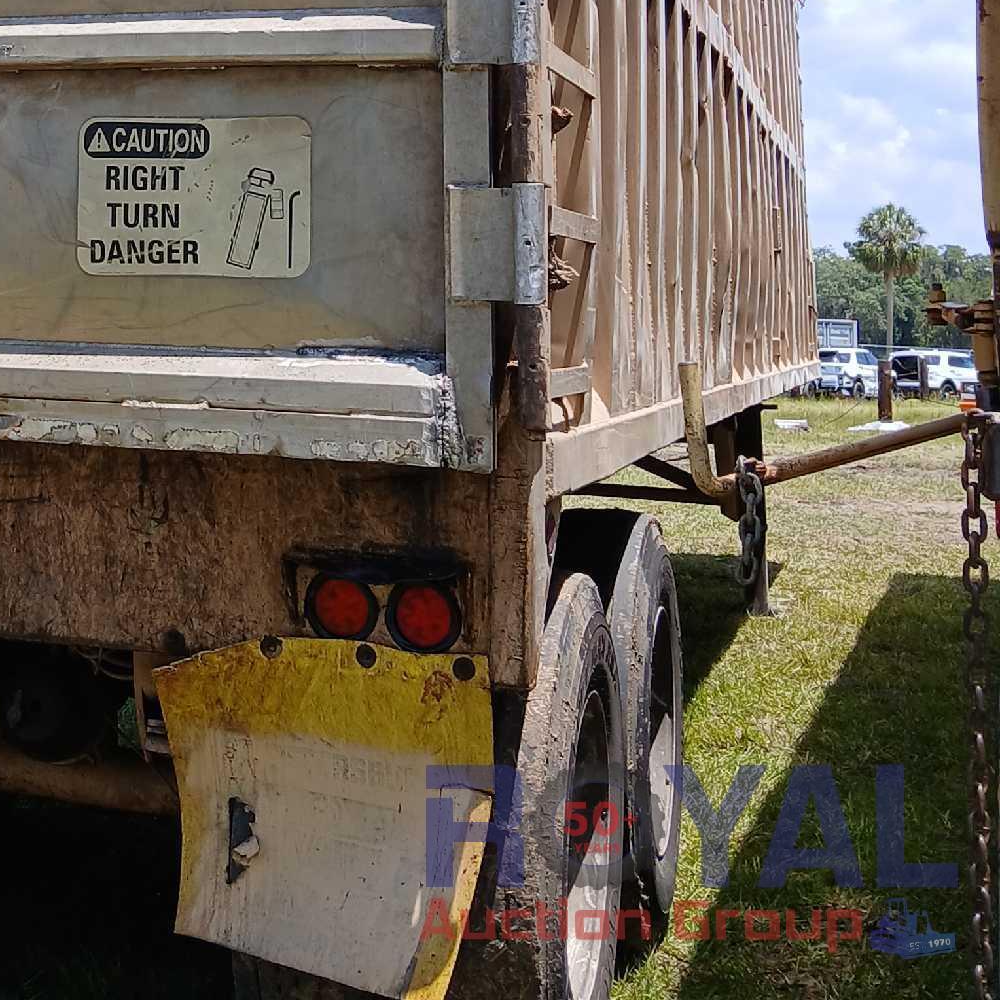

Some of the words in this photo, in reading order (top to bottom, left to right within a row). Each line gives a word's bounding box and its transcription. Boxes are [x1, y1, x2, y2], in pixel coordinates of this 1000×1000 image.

[112, 127, 205, 154] CAUTION
[105, 165, 185, 191] RIGHT
[106, 202, 180, 228] TURN
[90, 239, 199, 264] DANGER
